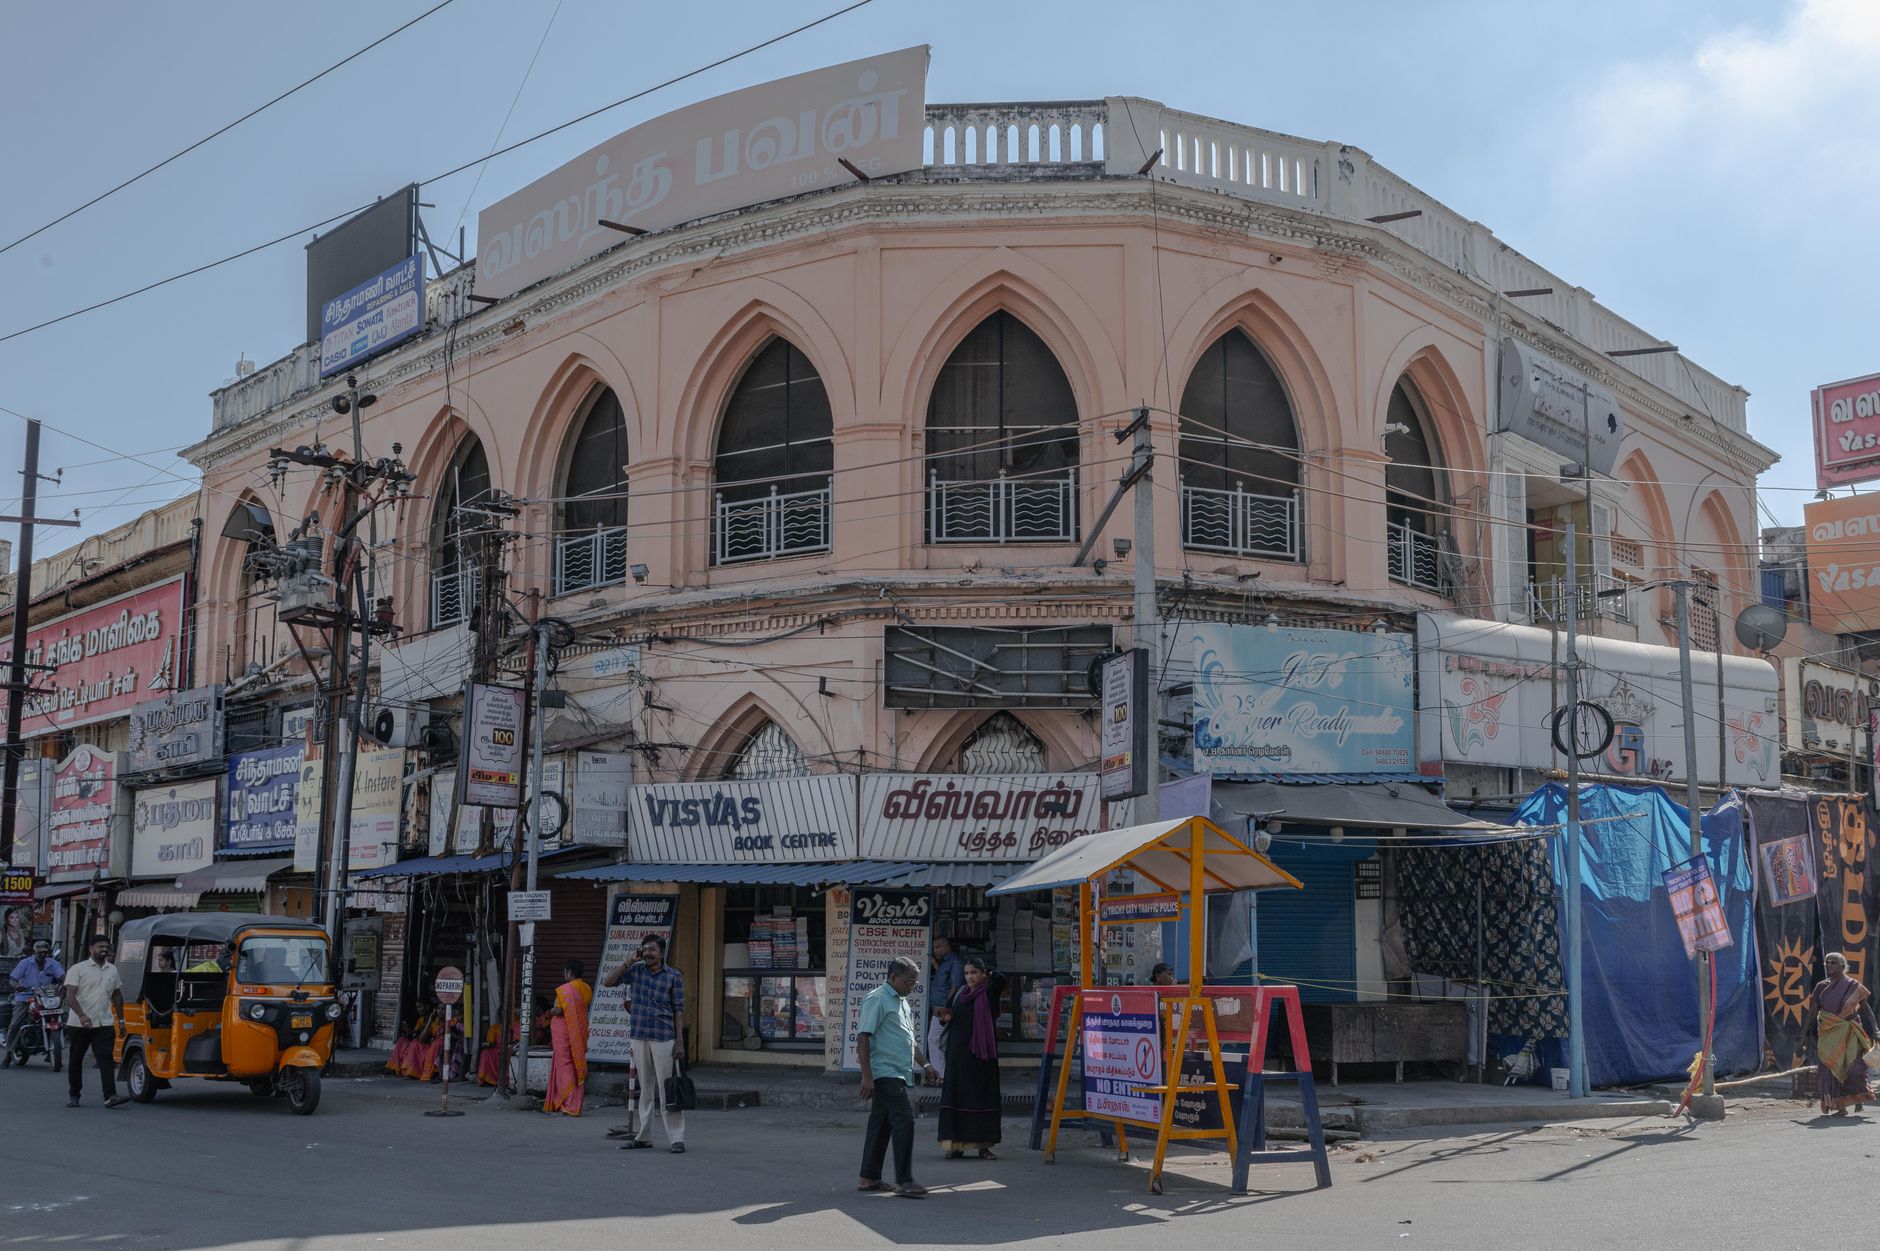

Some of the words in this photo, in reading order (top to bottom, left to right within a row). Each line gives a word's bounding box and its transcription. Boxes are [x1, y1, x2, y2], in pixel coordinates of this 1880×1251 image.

[483, 154, 673, 279] வஸந்த
[693, 70, 909, 187] பவன்
[790, 167, 818, 189] 100
[399, 279, 416, 294] SALES
[356, 309, 385, 335] SONATA
[324, 349, 347, 367] CASIO
[1114, 705, 1127, 722] 100
[494, 729, 514, 745] 100
[235, 749, 305, 787] சிந்தாமணி
[365, 766, 397, 793] Instore
[883, 779, 1083, 820] விஸ்வாஸ்
[150, 788, 215, 833] பத்மா
[645, 791, 761, 832] VISVAS
[734, 834, 774, 851] BOOK
[781, 832, 838, 849] CENTRE
[958, 826, 1018, 851] புத்தக
[157, 836, 204, 862] காபி
[3, 876, 33, 891] 1500
[618, 898, 670, 914] விஸ்வாஸ்
[1108, 904, 1125, 915] TRICHY
[1126, 903, 1138, 914] CITY
[1138, 902, 1159, 913] TRAFFIC
[1160, 901, 1178, 912] POLICE
[869, 917, 892, 925] BOOK
[892, 918, 921, 926] CENTRE
[858, 927, 887, 937] CBSE
[892, 928, 924, 939] NCERT
[898, 940, 926, 948] COLLEGE
[443, 979, 463, 993] PARKING
[1096, 1078, 1112, 1094] NO
[1113, 1080, 1147, 1099] ENTRY
